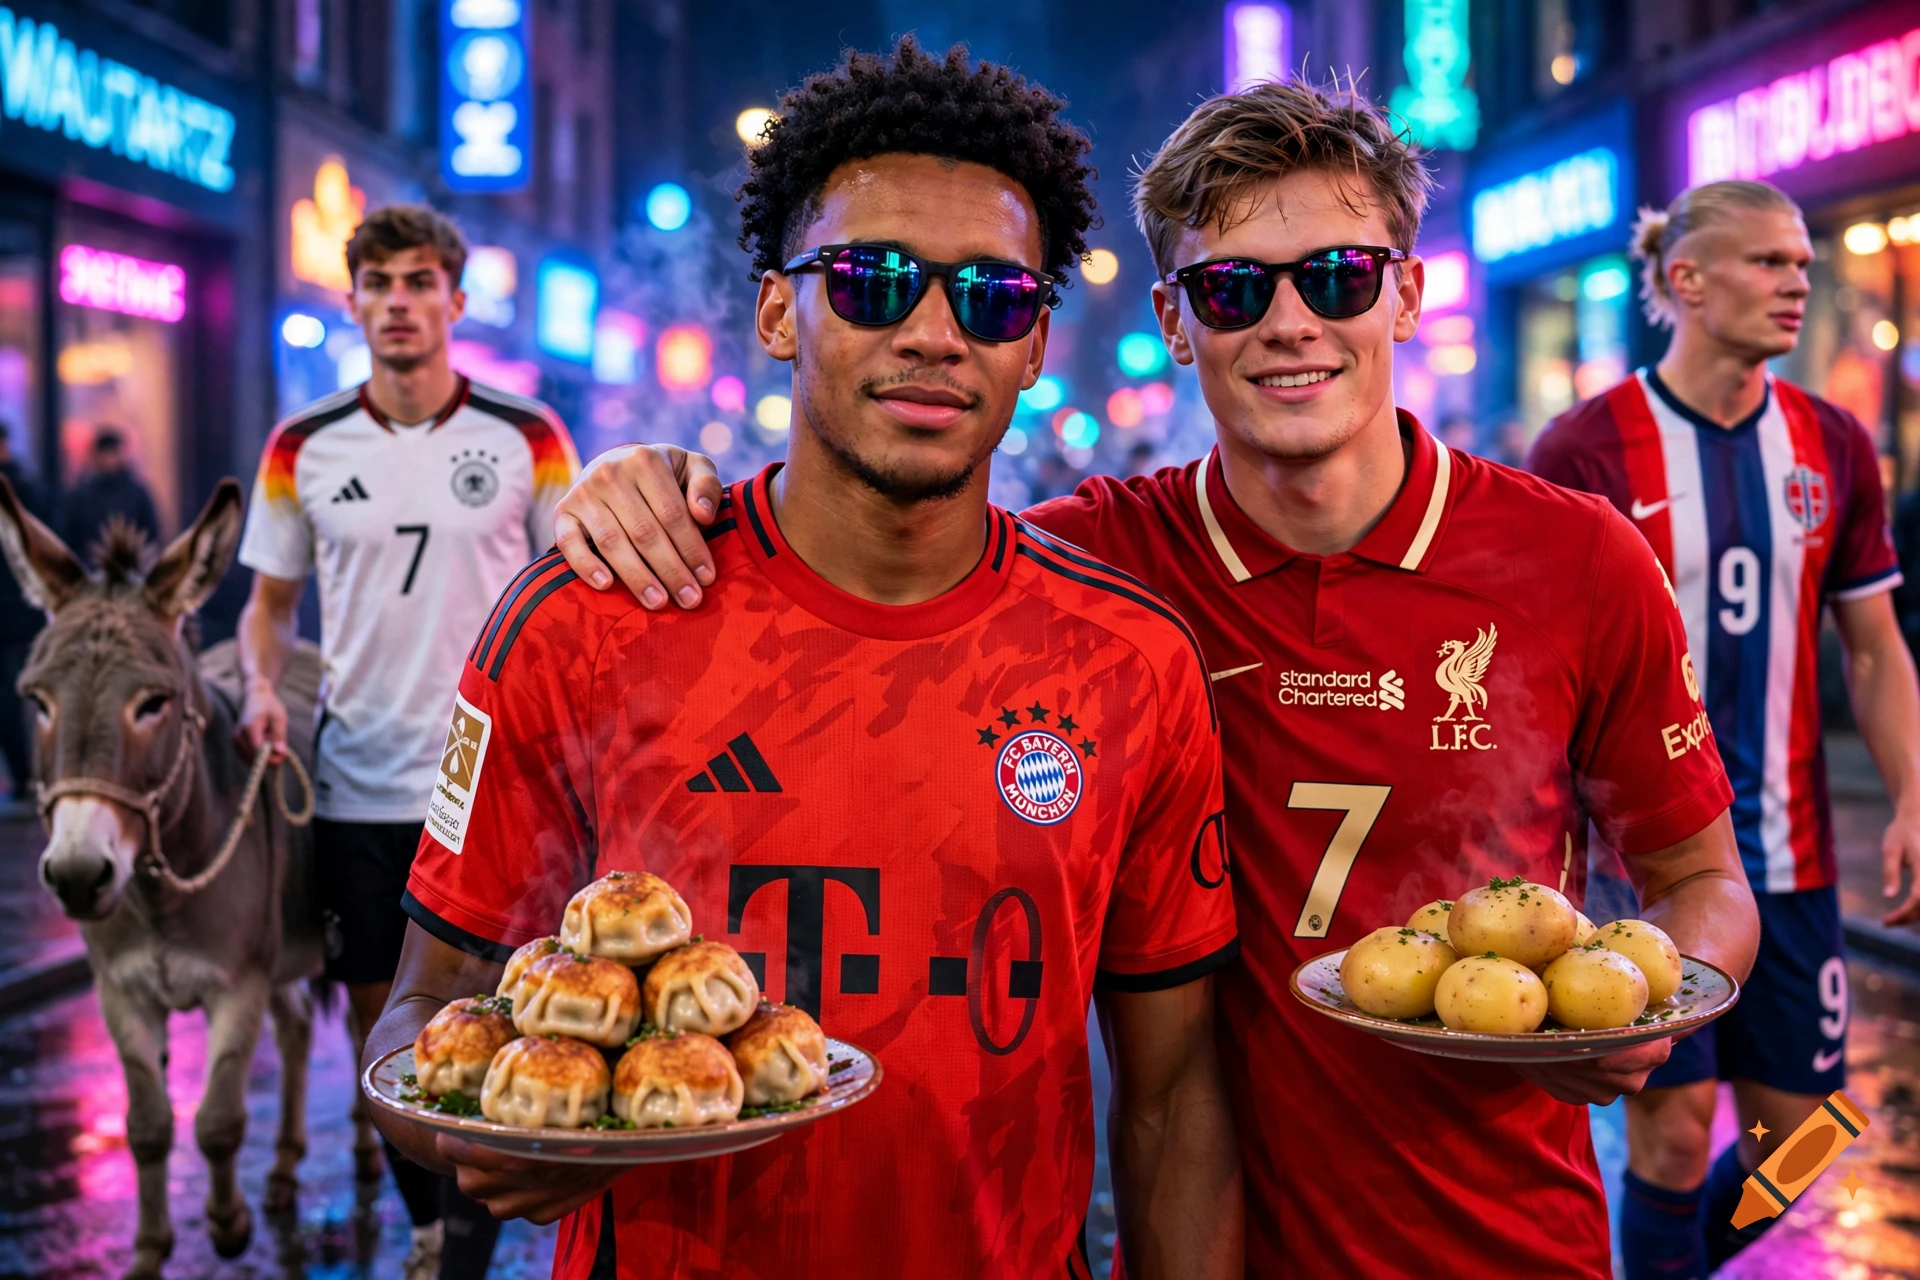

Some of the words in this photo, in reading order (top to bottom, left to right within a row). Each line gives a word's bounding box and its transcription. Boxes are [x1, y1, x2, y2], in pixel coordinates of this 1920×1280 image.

[395, 525, 430, 596] 7
[1718, 546, 1761, 635] 9
[1278, 688, 1378, 707] Chartered
[1003, 747, 1021, 769] FC
[1021, 736, 1077, 775] BAYERN
[1429, 724, 1498, 751] L.F.C.
[1286, 781, 1393, 939] 7
[1818, 956, 1849, 1040] 9
